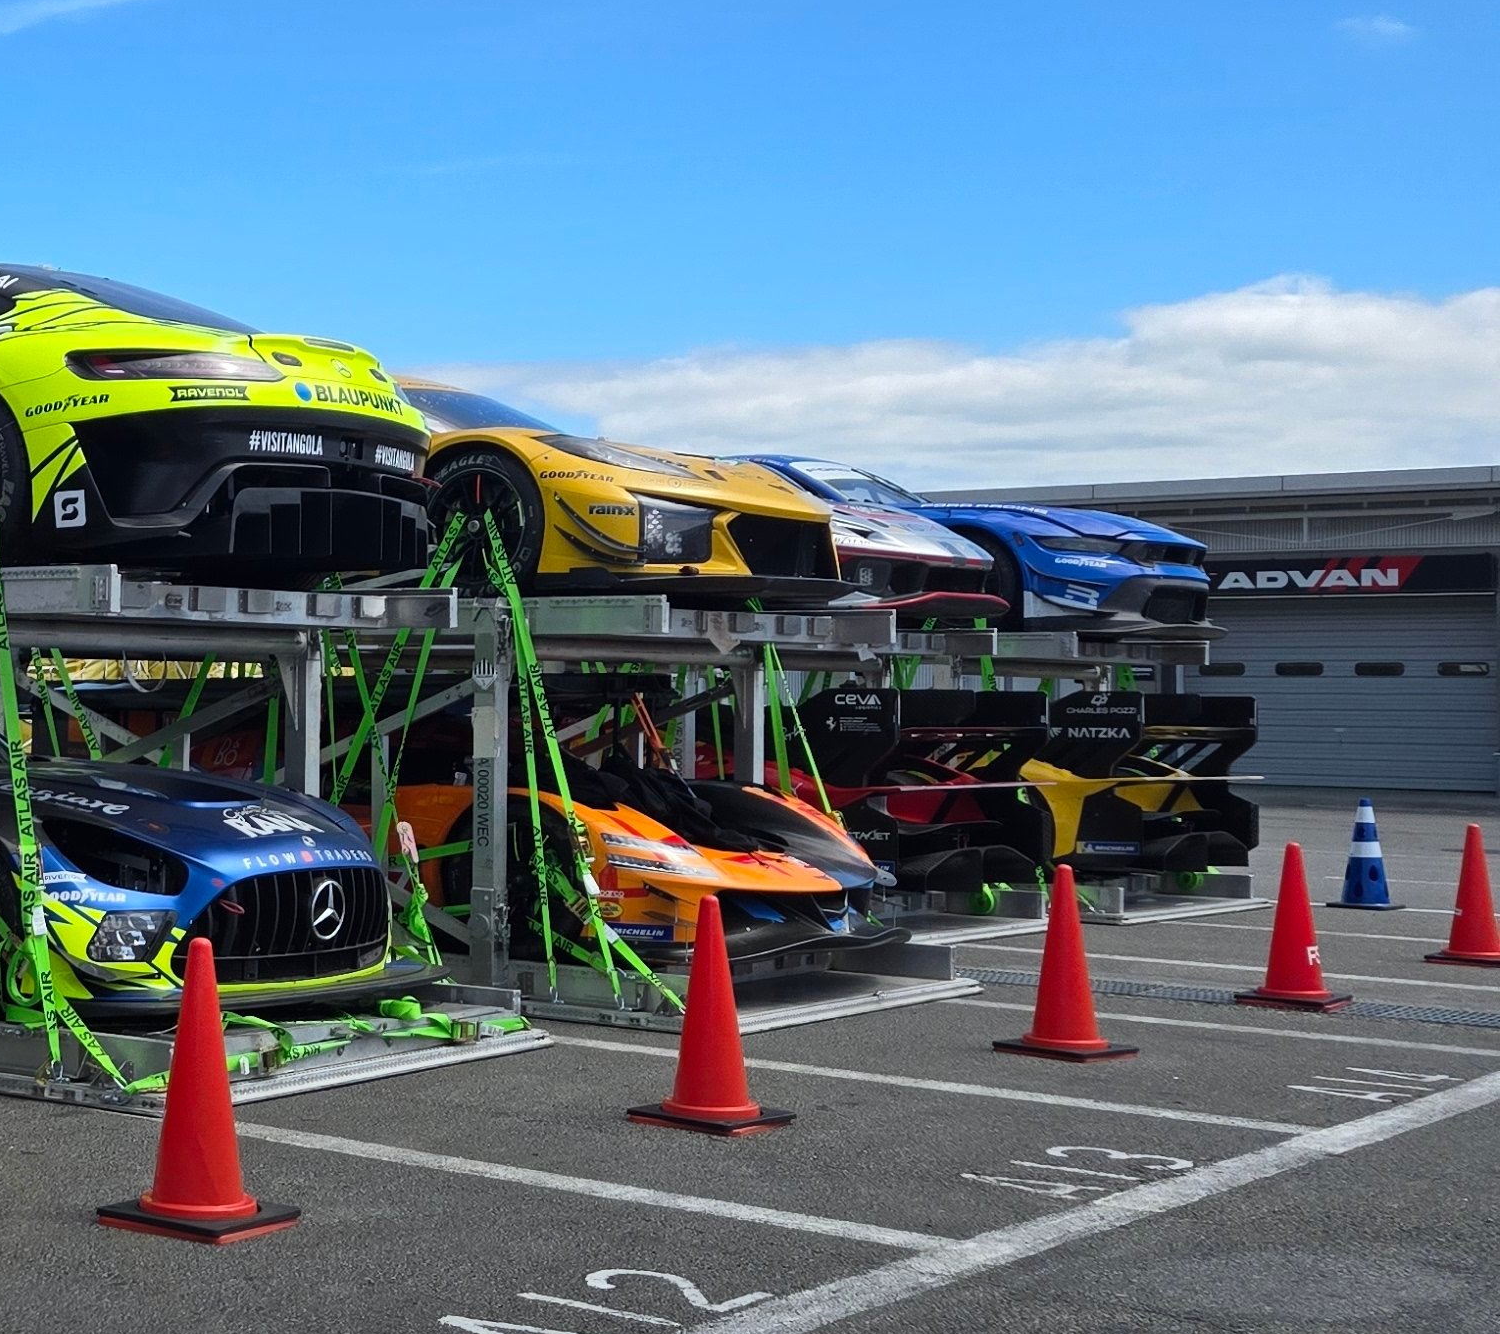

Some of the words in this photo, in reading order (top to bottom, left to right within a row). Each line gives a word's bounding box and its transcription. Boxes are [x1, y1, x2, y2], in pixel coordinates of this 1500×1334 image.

[25, 393, 110, 418] GOODYEAR
[177, 387, 244, 399] RAVENOL
[314, 384, 404, 416] BLAUPUNKT
[249, 430, 324, 456] #VISITANGOLA
[374, 443, 416, 472] #VISITANGOLA
[539, 469, 615, 483] GOODYEAR
[486, 517, 501, 542] AIR
[431, 527, 458, 571] ATLAS
[495, 543, 517, 585] ATLAS
[1054, 557, 1107, 569] GOODYEAR
[1217, 568, 1400, 590] ADVAN
[369, 666, 394, 714] ATLAS
[388, 640, 403, 667] AIR
[529, 661, 544, 691] AIR
[37, 684, 50, 708] AIR
[68, 690, 83, 711] AIR
[518, 675, 532, 730] ATLAS
[78, 711, 100, 751] ATLAS
[535, 692, 557, 740] ATLAS
[523, 731, 534, 755] AIR
[1067, 727, 1132, 739] NATZKA
[9, 739, 26, 771] AIR
[476, 769, 490, 809] 00020
[14, 777, 34, 838] ATLAS
[476, 812, 490, 847] WEC
[848, 827, 891, 841] TAJET
[23, 852, 37, 887] AIR
[243, 851, 298, 870] FLOW
[313, 849, 373, 863] TRADERS
[49, 888, 127, 904] OODYEAR
[537, 877, 549, 907] AIR
[612, 926, 665, 937] MICHELIN
[39, 969, 55, 1005] AIR
[58, 1004, 79, 1034] AIR
[959, 1144, 1194, 1200] A13
